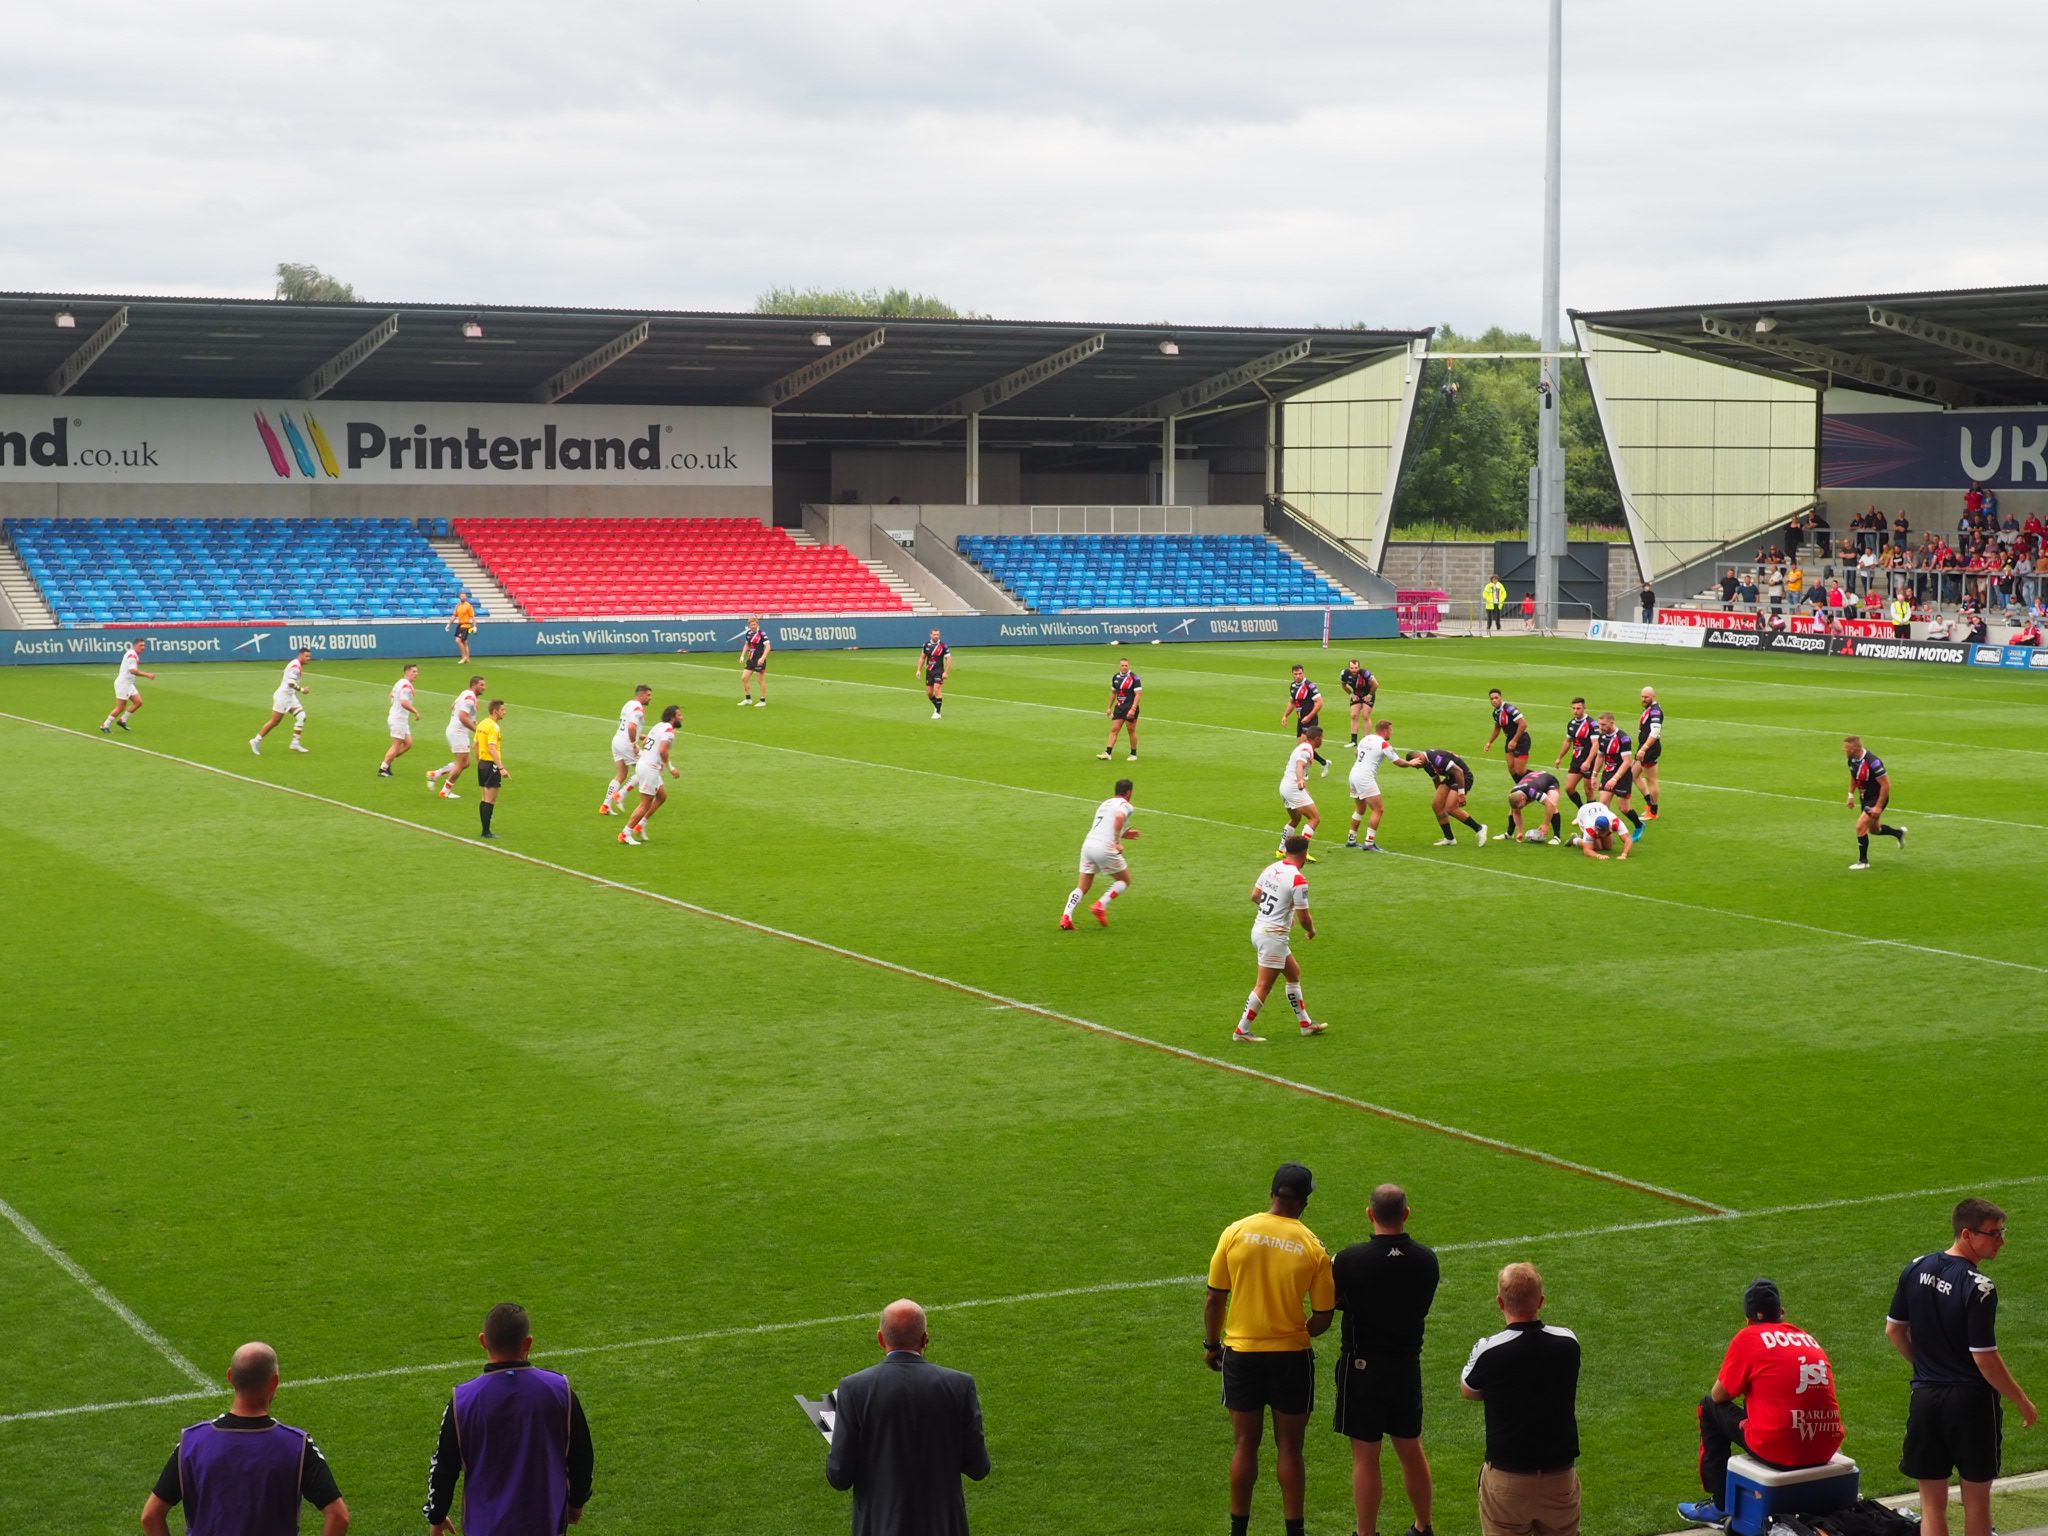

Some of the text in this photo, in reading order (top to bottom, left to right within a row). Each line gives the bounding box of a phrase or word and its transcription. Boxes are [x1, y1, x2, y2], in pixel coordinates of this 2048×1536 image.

[536, 626, 857, 645] Austin Wilkinson Transport 01942 887000
[1000, 619, 1278, 637] Austin Wilkinson Transport 01942 887000
[14, 634, 377, 655] Austin Wilkinso Transport 01942 887000
[1722, 631, 1760, 646] Kappa
[1786, 635, 1825, 650] Kappa
[1855, 643, 1917, 660] MITSUBISHI
[1918, 647, 1964, 663] MOTORS
[1243, 1232, 1305, 1256] TRAINER
